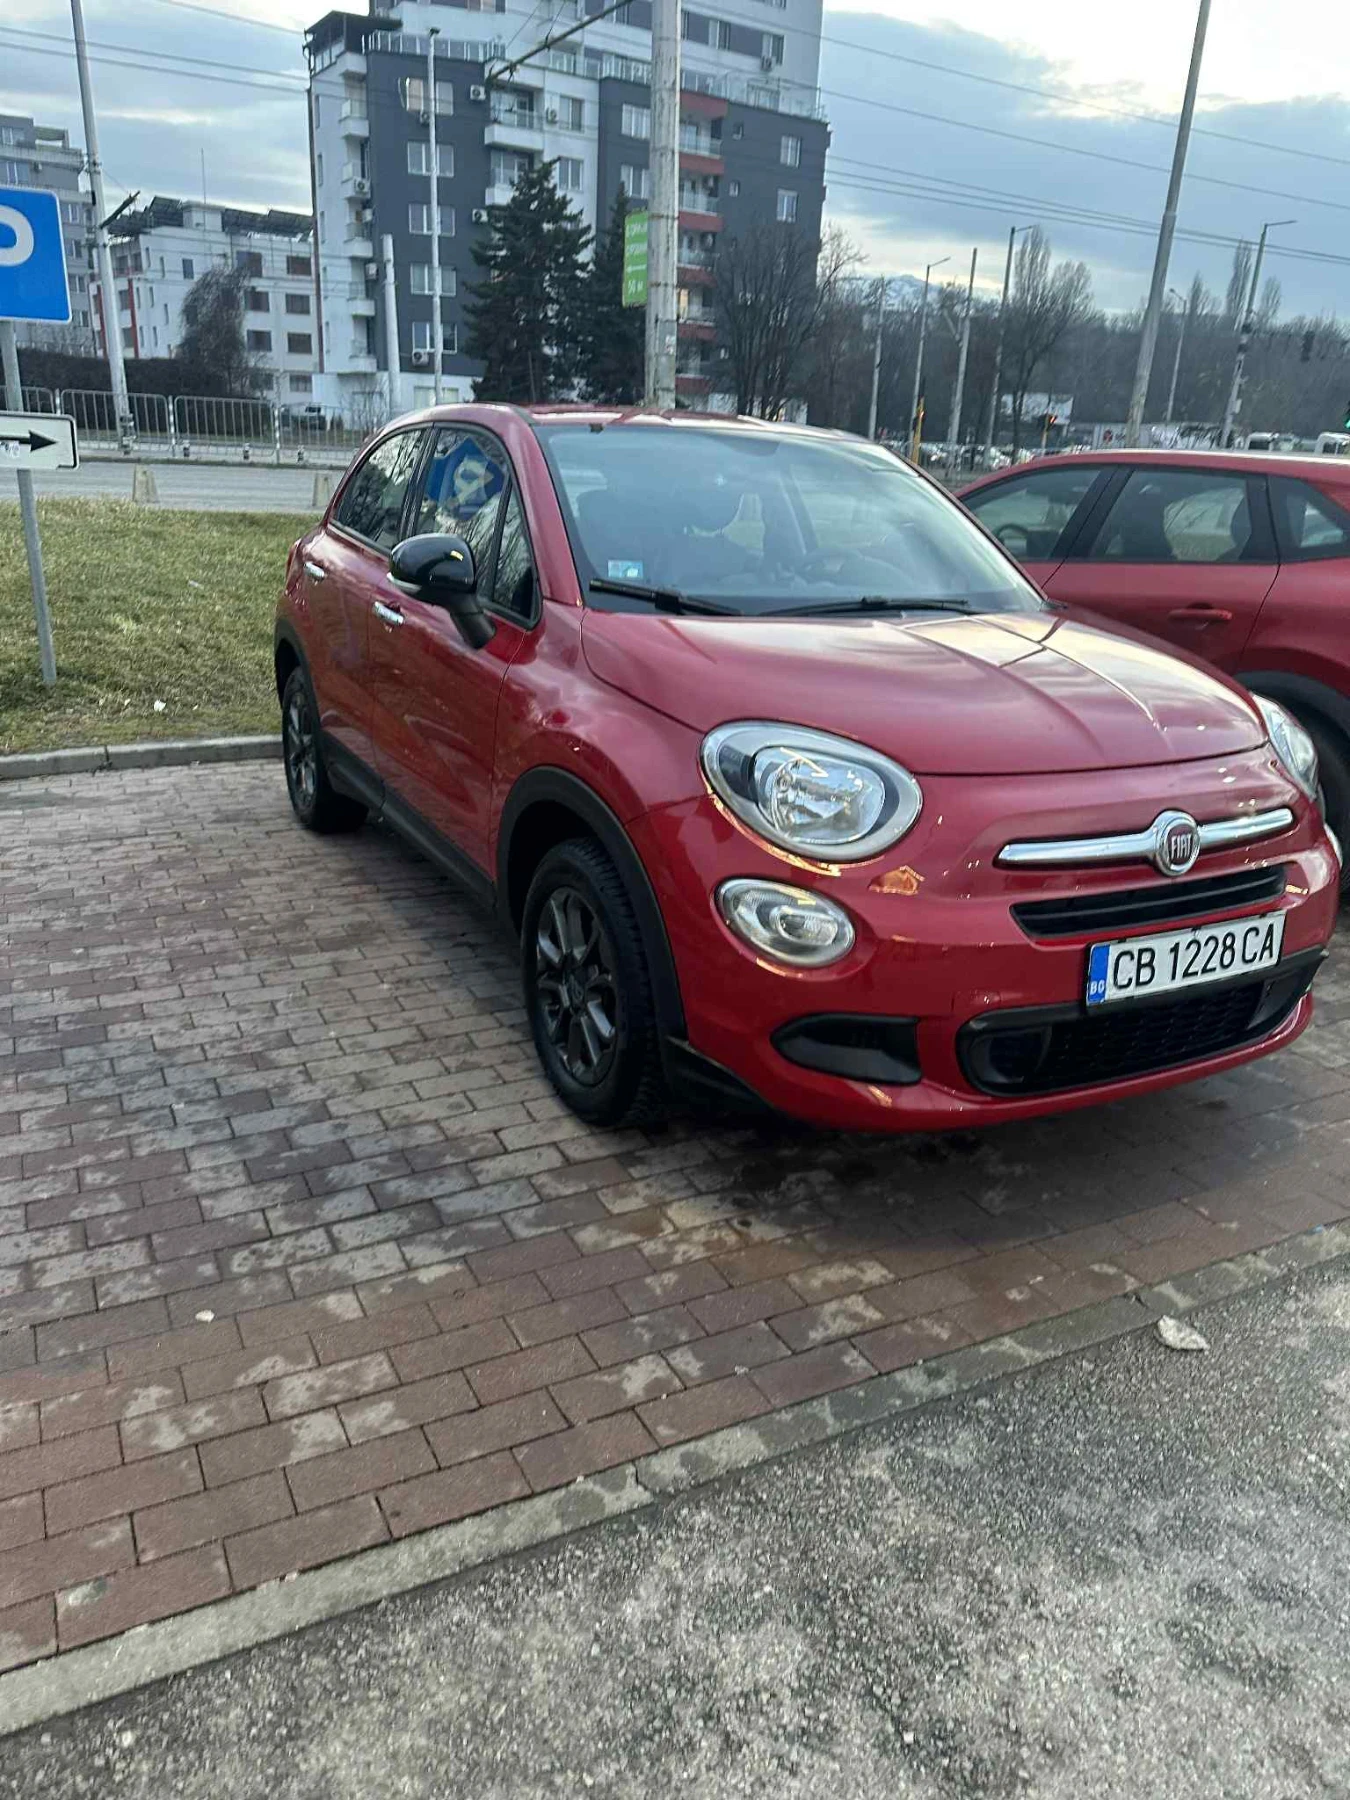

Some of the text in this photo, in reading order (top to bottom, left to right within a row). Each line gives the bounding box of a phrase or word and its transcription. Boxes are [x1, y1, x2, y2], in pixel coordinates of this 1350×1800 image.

[1171, 833, 1192, 861] FIAT
[1112, 923, 1274, 990] CB 1228 CA
